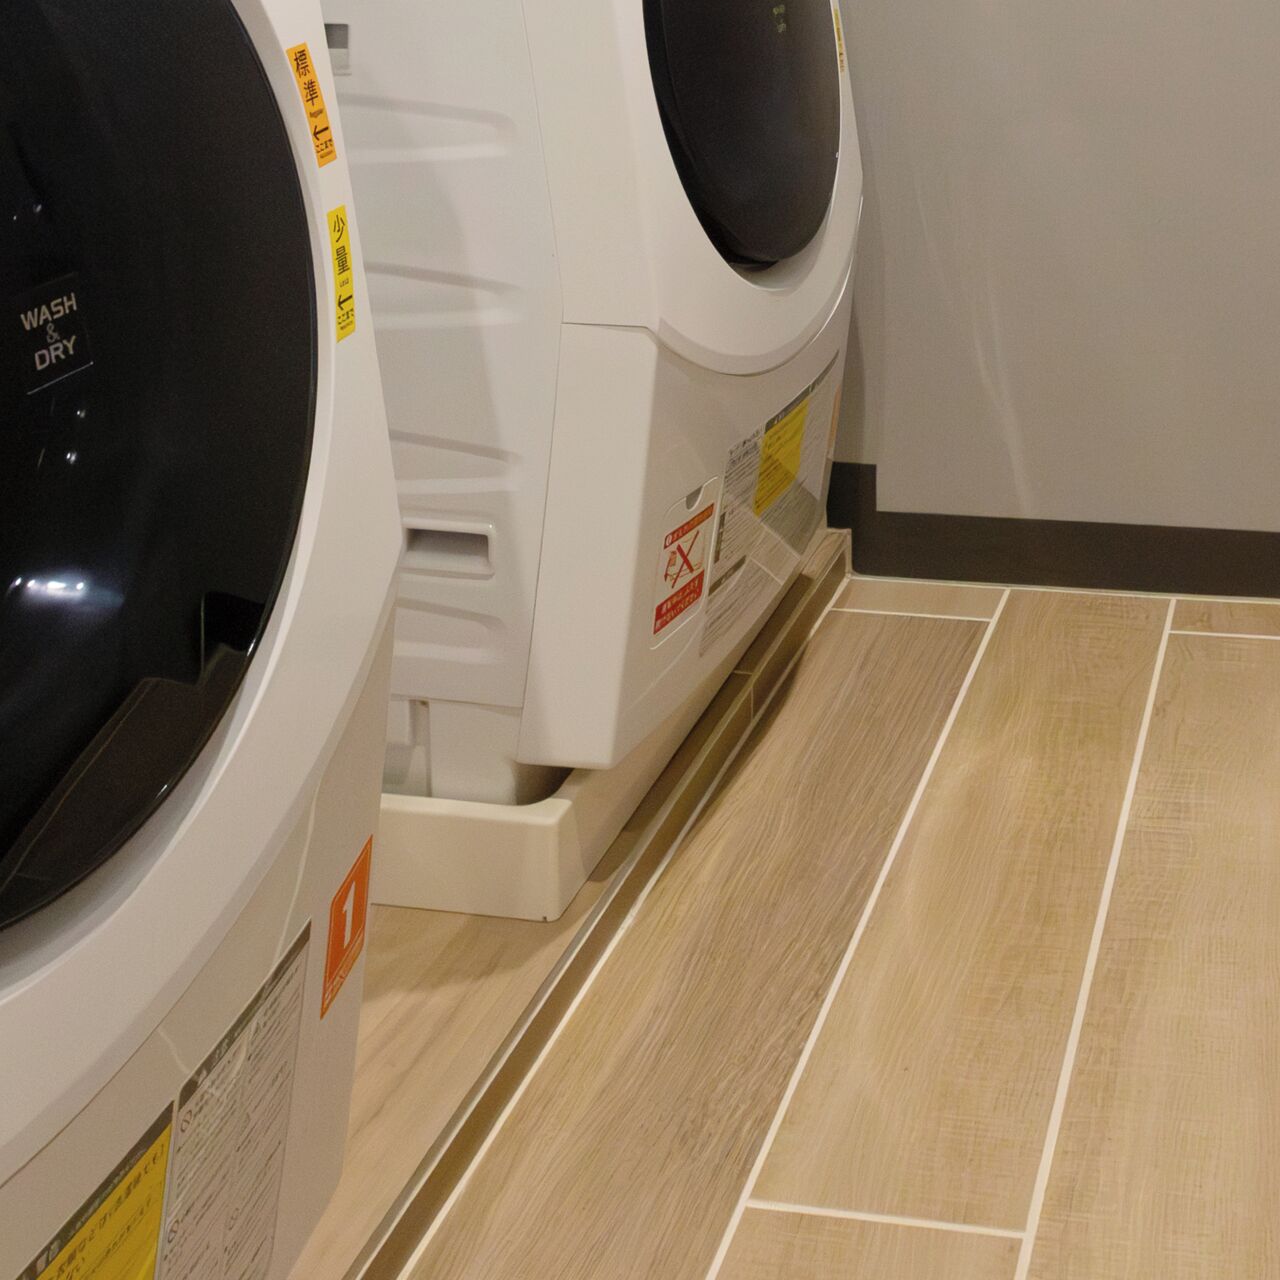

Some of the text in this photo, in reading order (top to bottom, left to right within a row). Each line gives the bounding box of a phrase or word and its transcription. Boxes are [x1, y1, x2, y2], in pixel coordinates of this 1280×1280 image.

[293, 49, 318, 106] 標準
[332, 214, 349, 277] 少量
[20, 292, 78, 331] WASH
[46, 322, 60, 343] &
[34, 335, 77, 371] DRY
